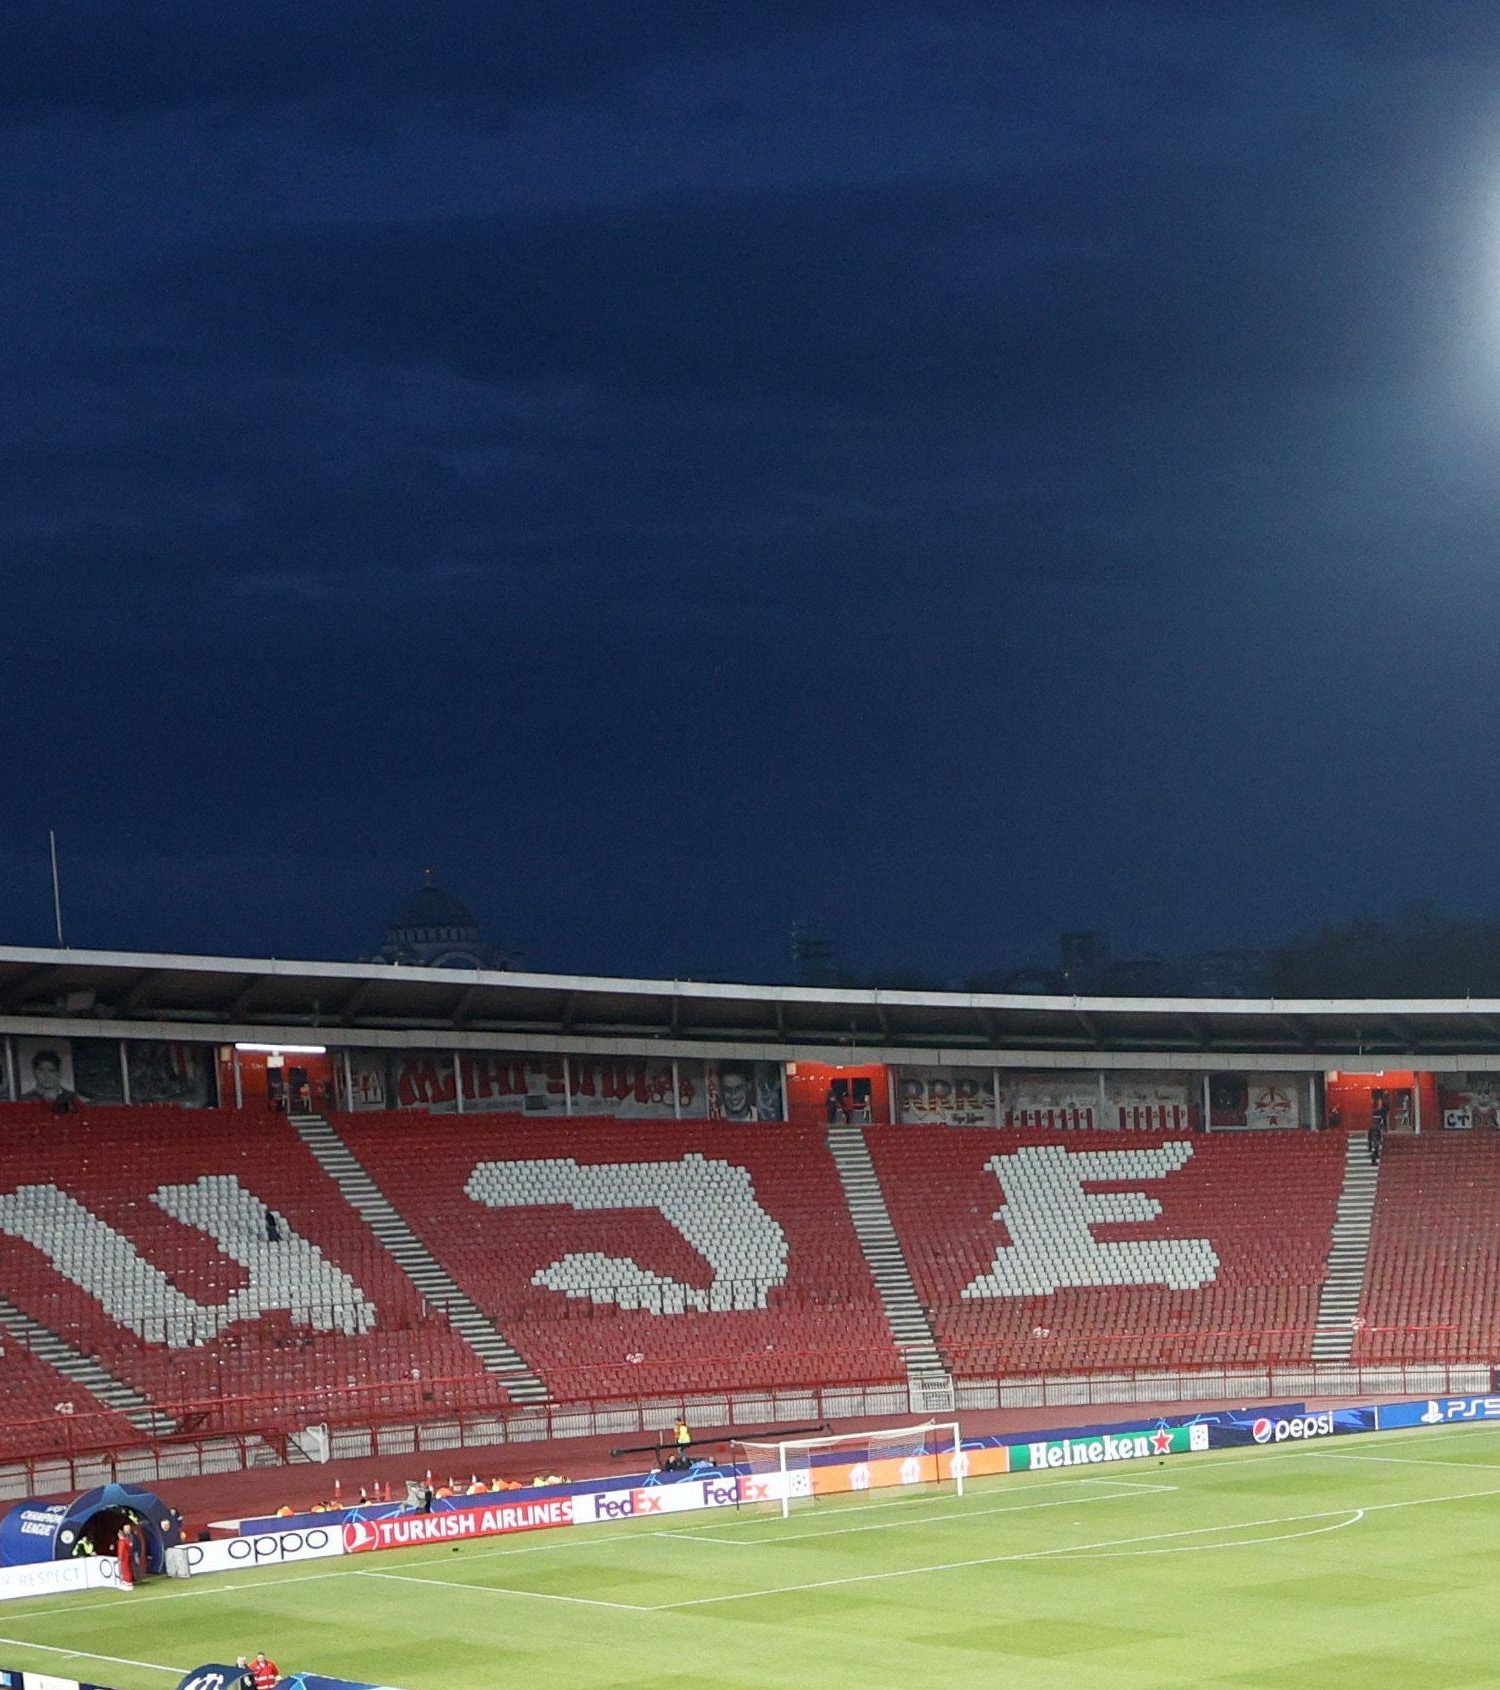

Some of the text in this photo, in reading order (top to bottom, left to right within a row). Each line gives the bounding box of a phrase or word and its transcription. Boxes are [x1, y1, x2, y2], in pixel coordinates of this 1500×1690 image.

[1274, 1411, 1335, 1442] pepsi
[1029, 1434, 1150, 1469] Heineken
[593, 1487, 663, 1520] FedEx
[702, 1474, 769, 1507] FedEx
[380, 1500, 573, 1544] TURKISH AIRLINES
[228, 1529, 329, 1564] oppo
[19, 1567, 81, 1587] RESPECT
